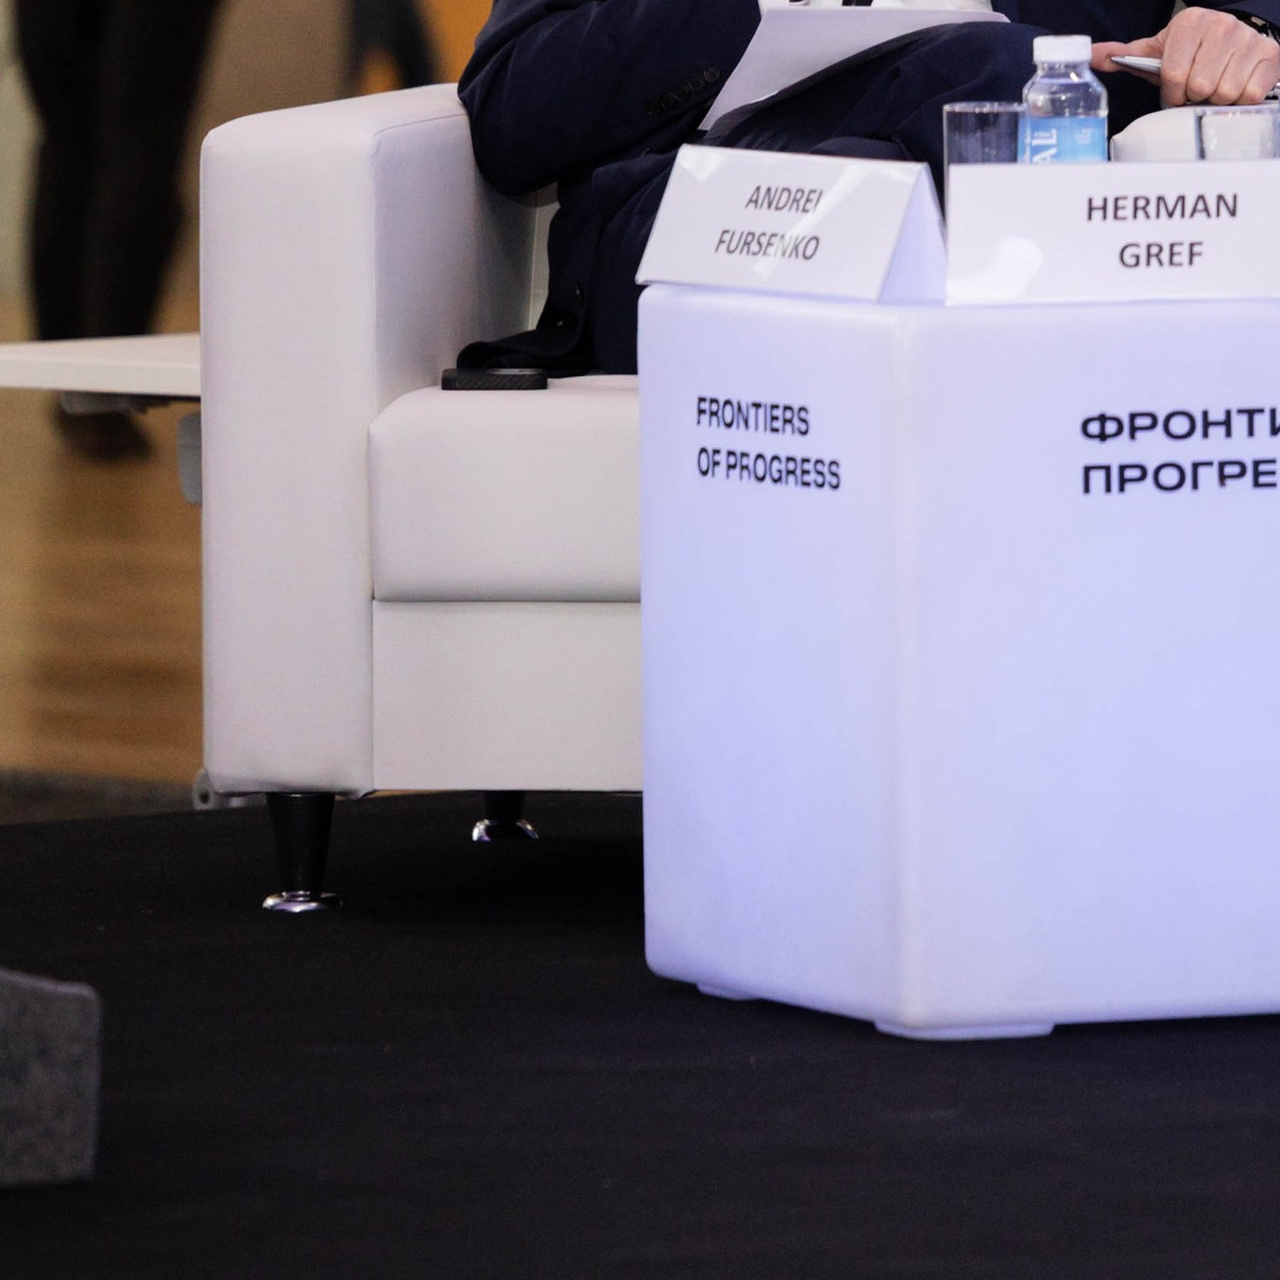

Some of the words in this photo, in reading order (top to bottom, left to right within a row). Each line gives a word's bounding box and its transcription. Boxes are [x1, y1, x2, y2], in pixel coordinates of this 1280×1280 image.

[745, 185, 823, 213] ANDREI
[1087, 193, 1238, 222] HERMAN
[714, 229, 820, 260] FURSENKO
[1119, 241, 1203, 269] GREF
[697, 396, 810, 436] FRONTIERS
[697, 447, 721, 478] OF
[726, 449, 841, 490] PROGRESS
